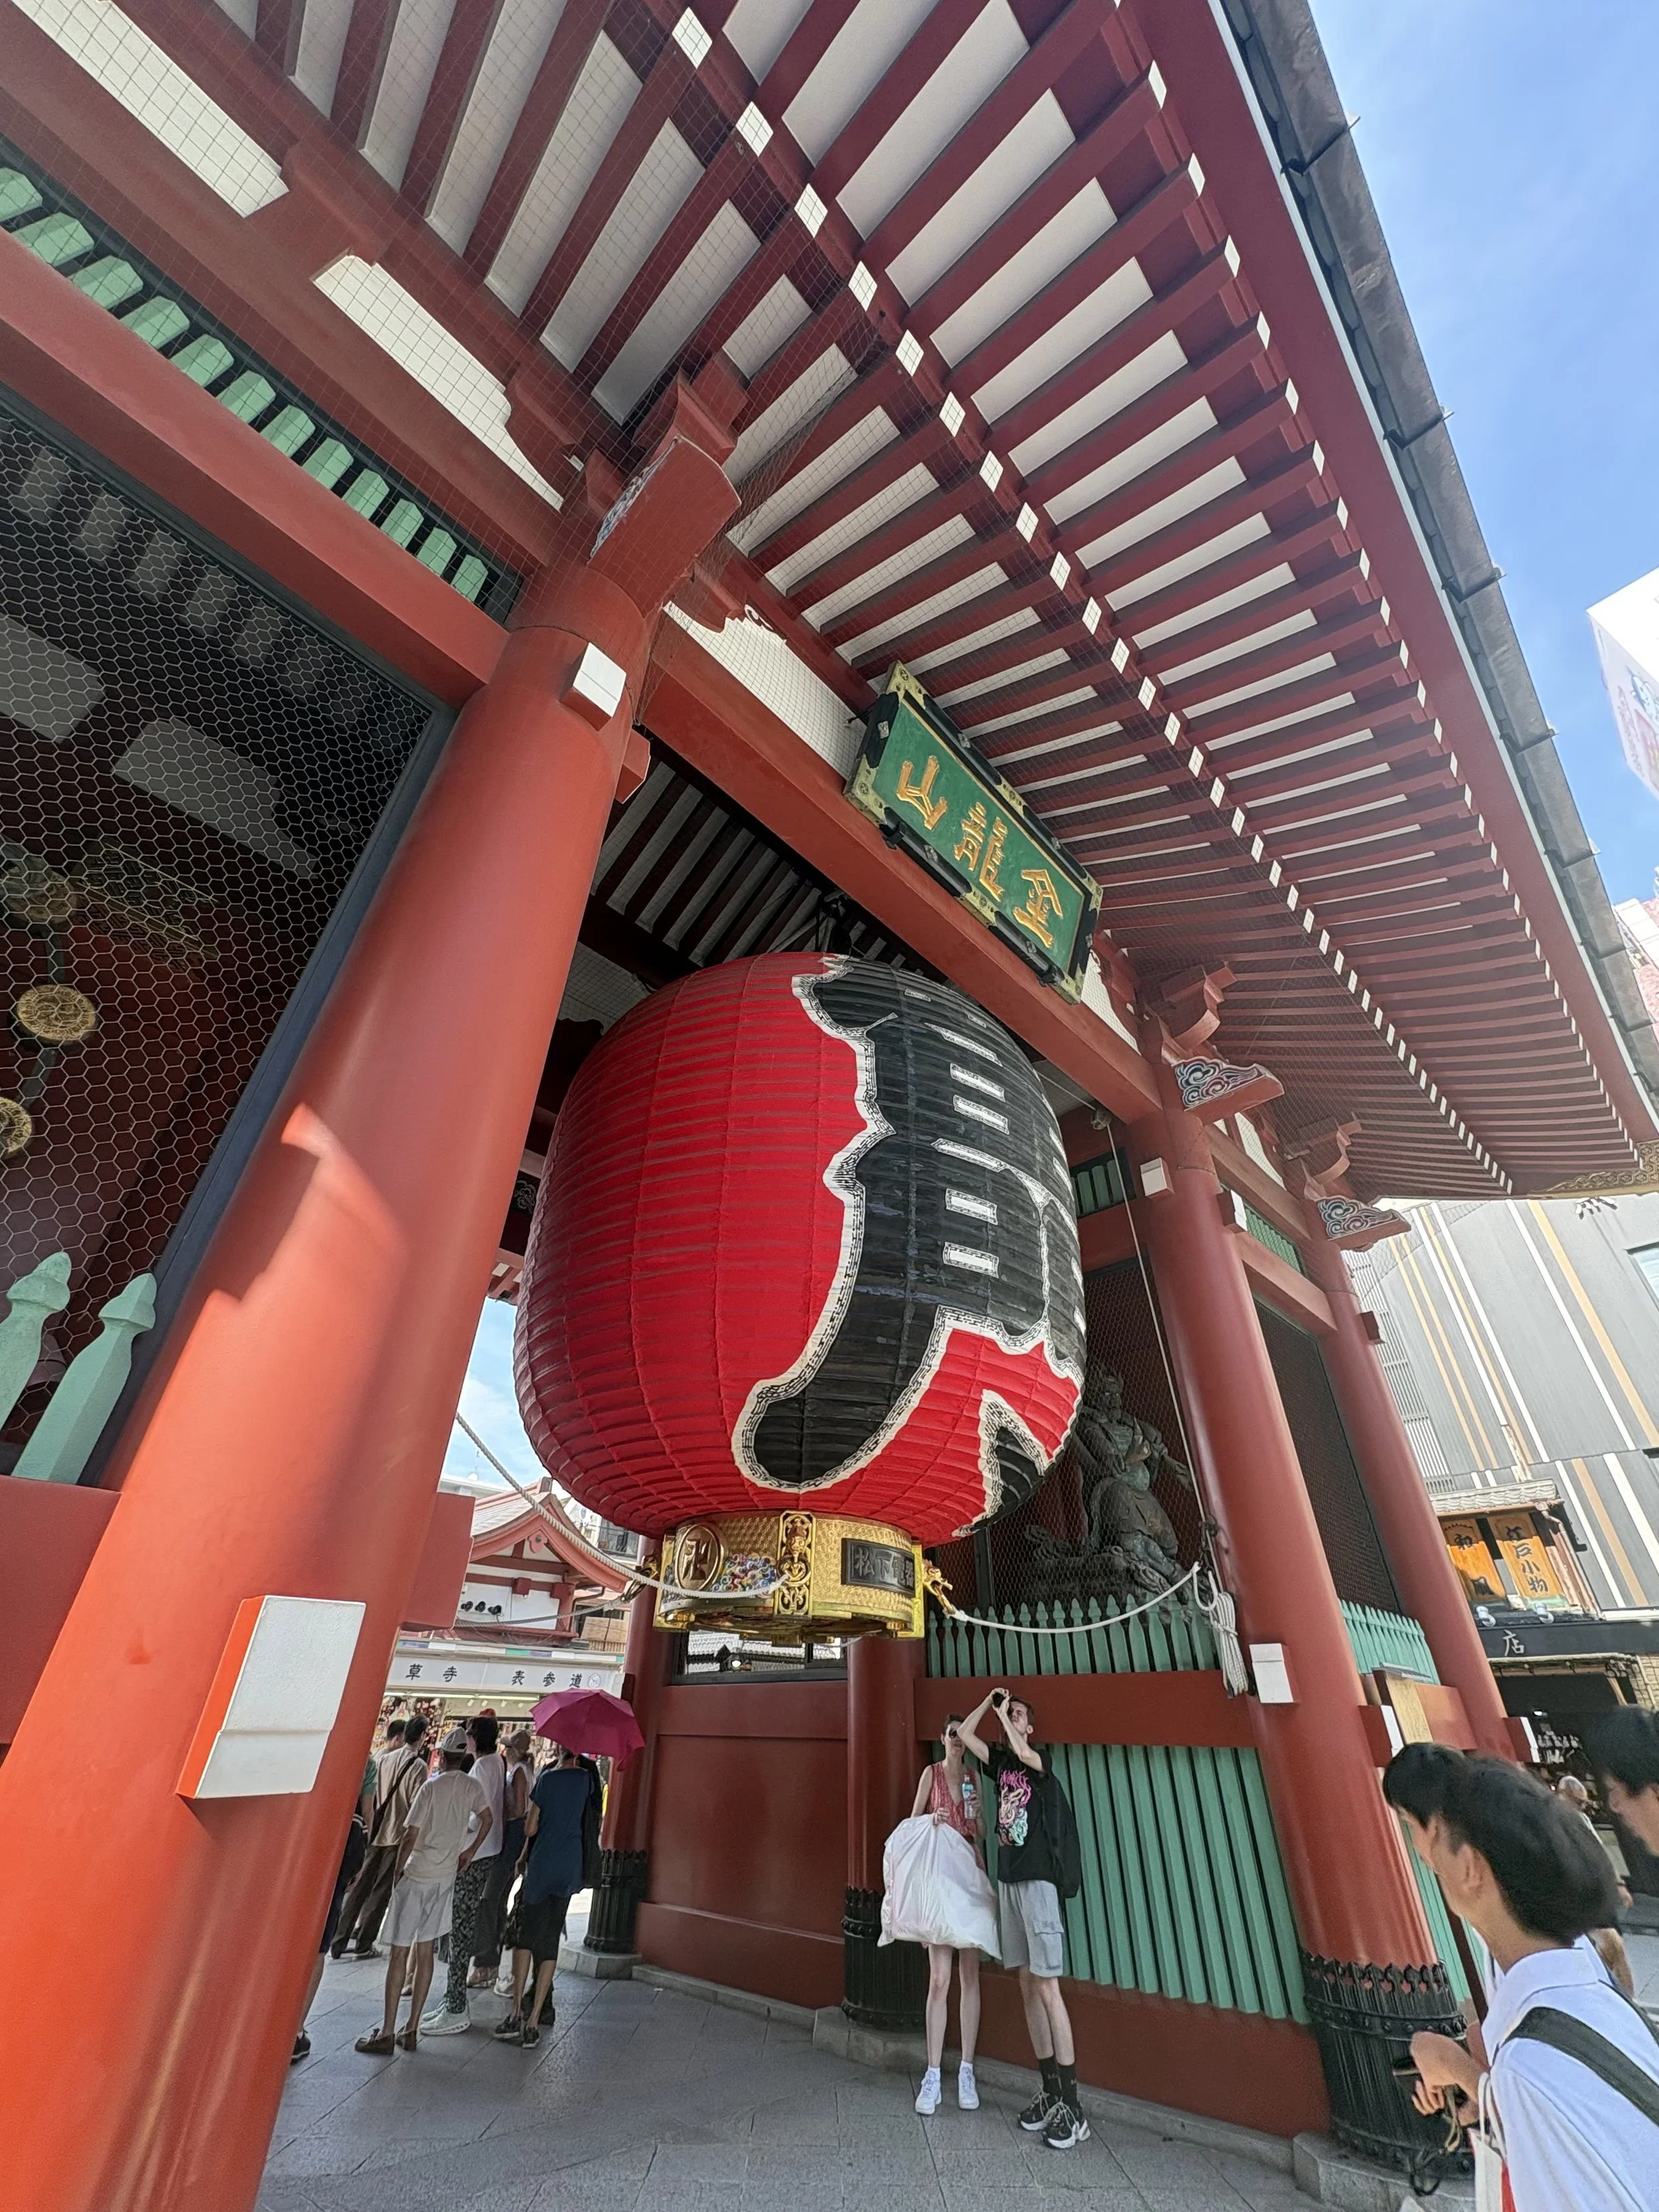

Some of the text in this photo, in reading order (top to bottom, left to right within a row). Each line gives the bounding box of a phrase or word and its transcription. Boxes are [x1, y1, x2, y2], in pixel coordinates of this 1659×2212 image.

[1505, 1526, 1549, 1593] 江戸小物
[1502, 1629, 1524, 1657] 店
